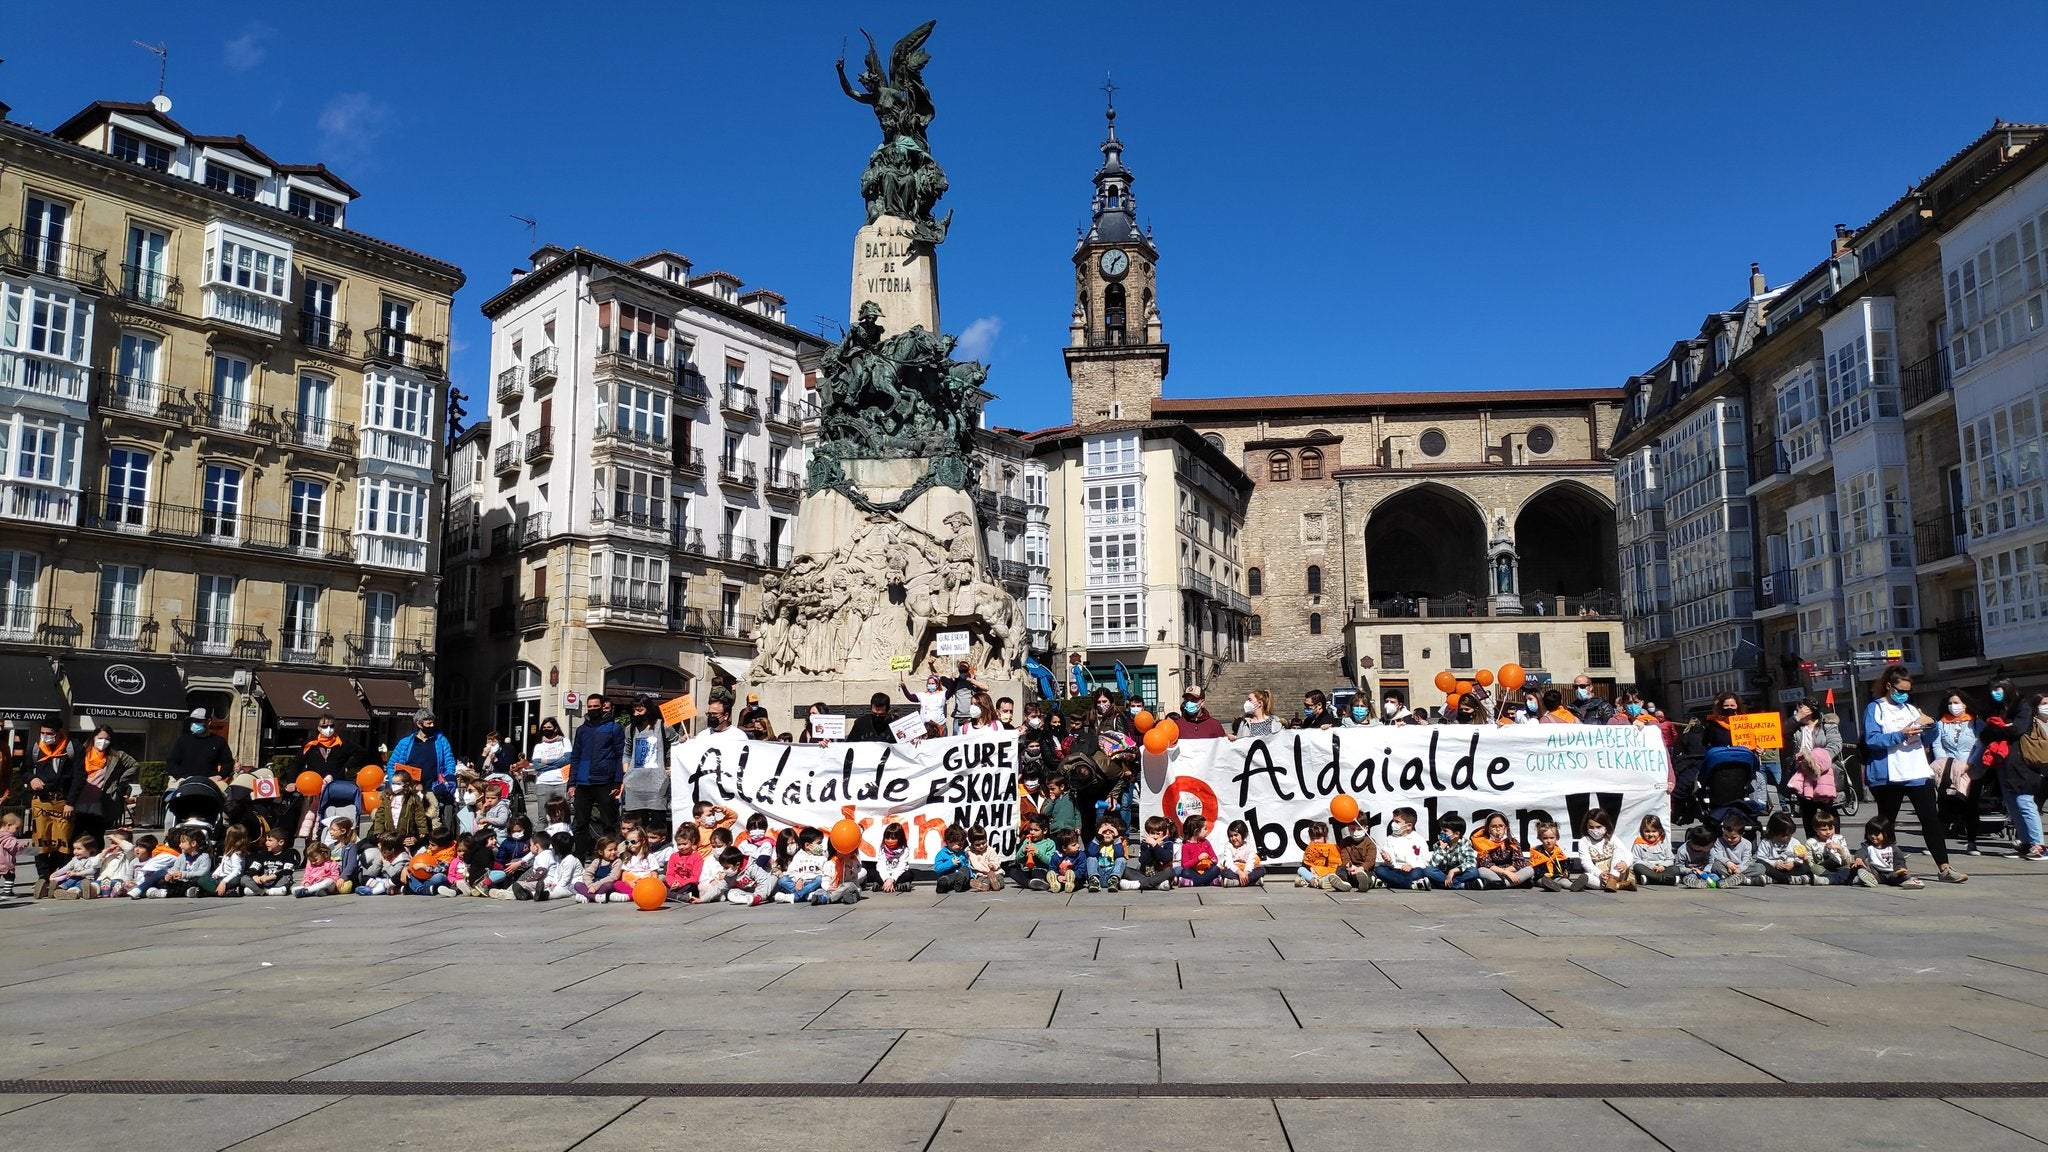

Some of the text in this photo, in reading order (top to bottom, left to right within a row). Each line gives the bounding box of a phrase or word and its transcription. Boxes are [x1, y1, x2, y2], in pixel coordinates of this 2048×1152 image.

[877, 227, 883, 237] A
[865, 242, 914, 258] BATALL
[884, 262, 895, 273] DE
[867, 277, 912, 293] VITORIA
[86, 707, 177, 720] COMIDA SALUDABLE BIO
[943, 741, 1013, 771] GURE
[1597, 750, 1667, 772] ELKARTEA
[688, 745, 909, 805] Aldaialde
[1232, 729, 1514, 807] Aldaialde
[926, 772, 1017, 804] ESKOLA
[954, 804, 1013, 829] NAHI
[1245, 793, 1624, 861] borrkn!!
